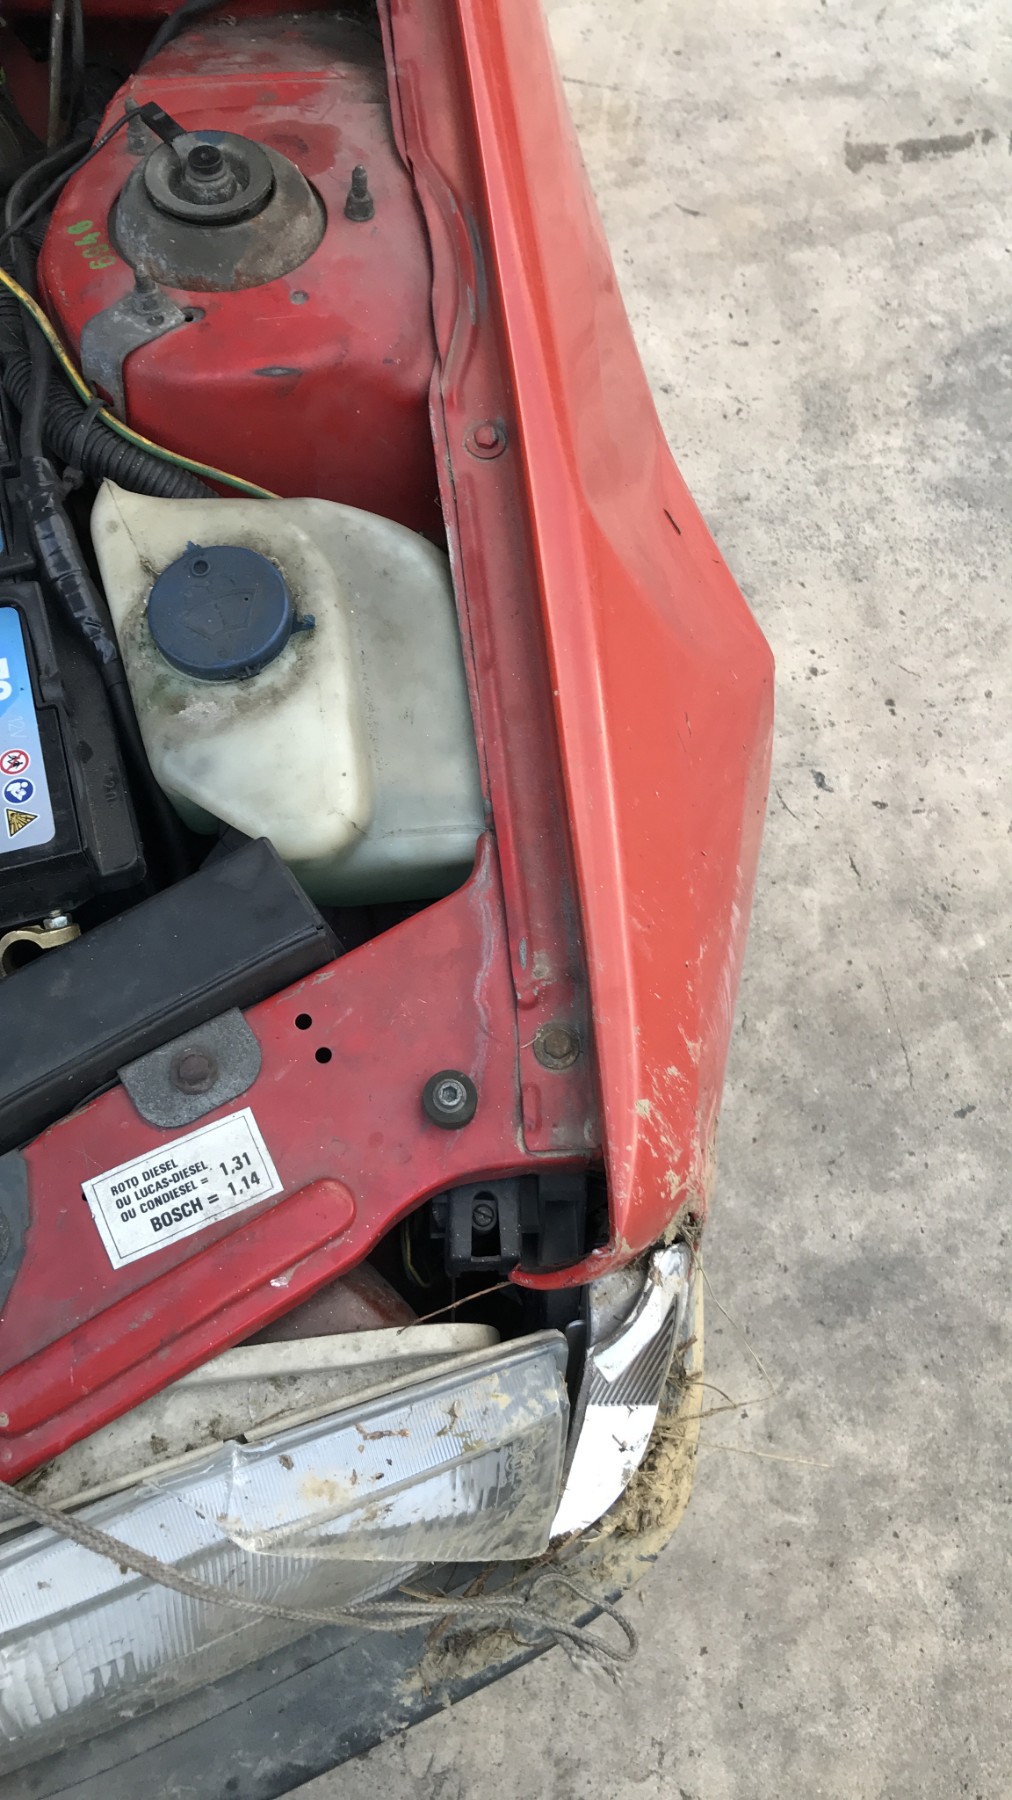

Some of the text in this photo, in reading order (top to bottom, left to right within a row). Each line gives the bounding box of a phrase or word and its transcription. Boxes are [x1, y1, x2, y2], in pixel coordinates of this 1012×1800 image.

[8, 716, 28, 738] 12V
[110, 1159, 179, 1196] ROTO DIESEL
[115, 1160, 209, 1210] OU LUCAS-DIESEL
[120, 1209, 137, 1223] OU
[139, 1180, 199, 1214] CONDIESEL
[219, 1151, 252, 1177] 1,31
[149, 1171, 261, 1232] BOSCH = 1,14
